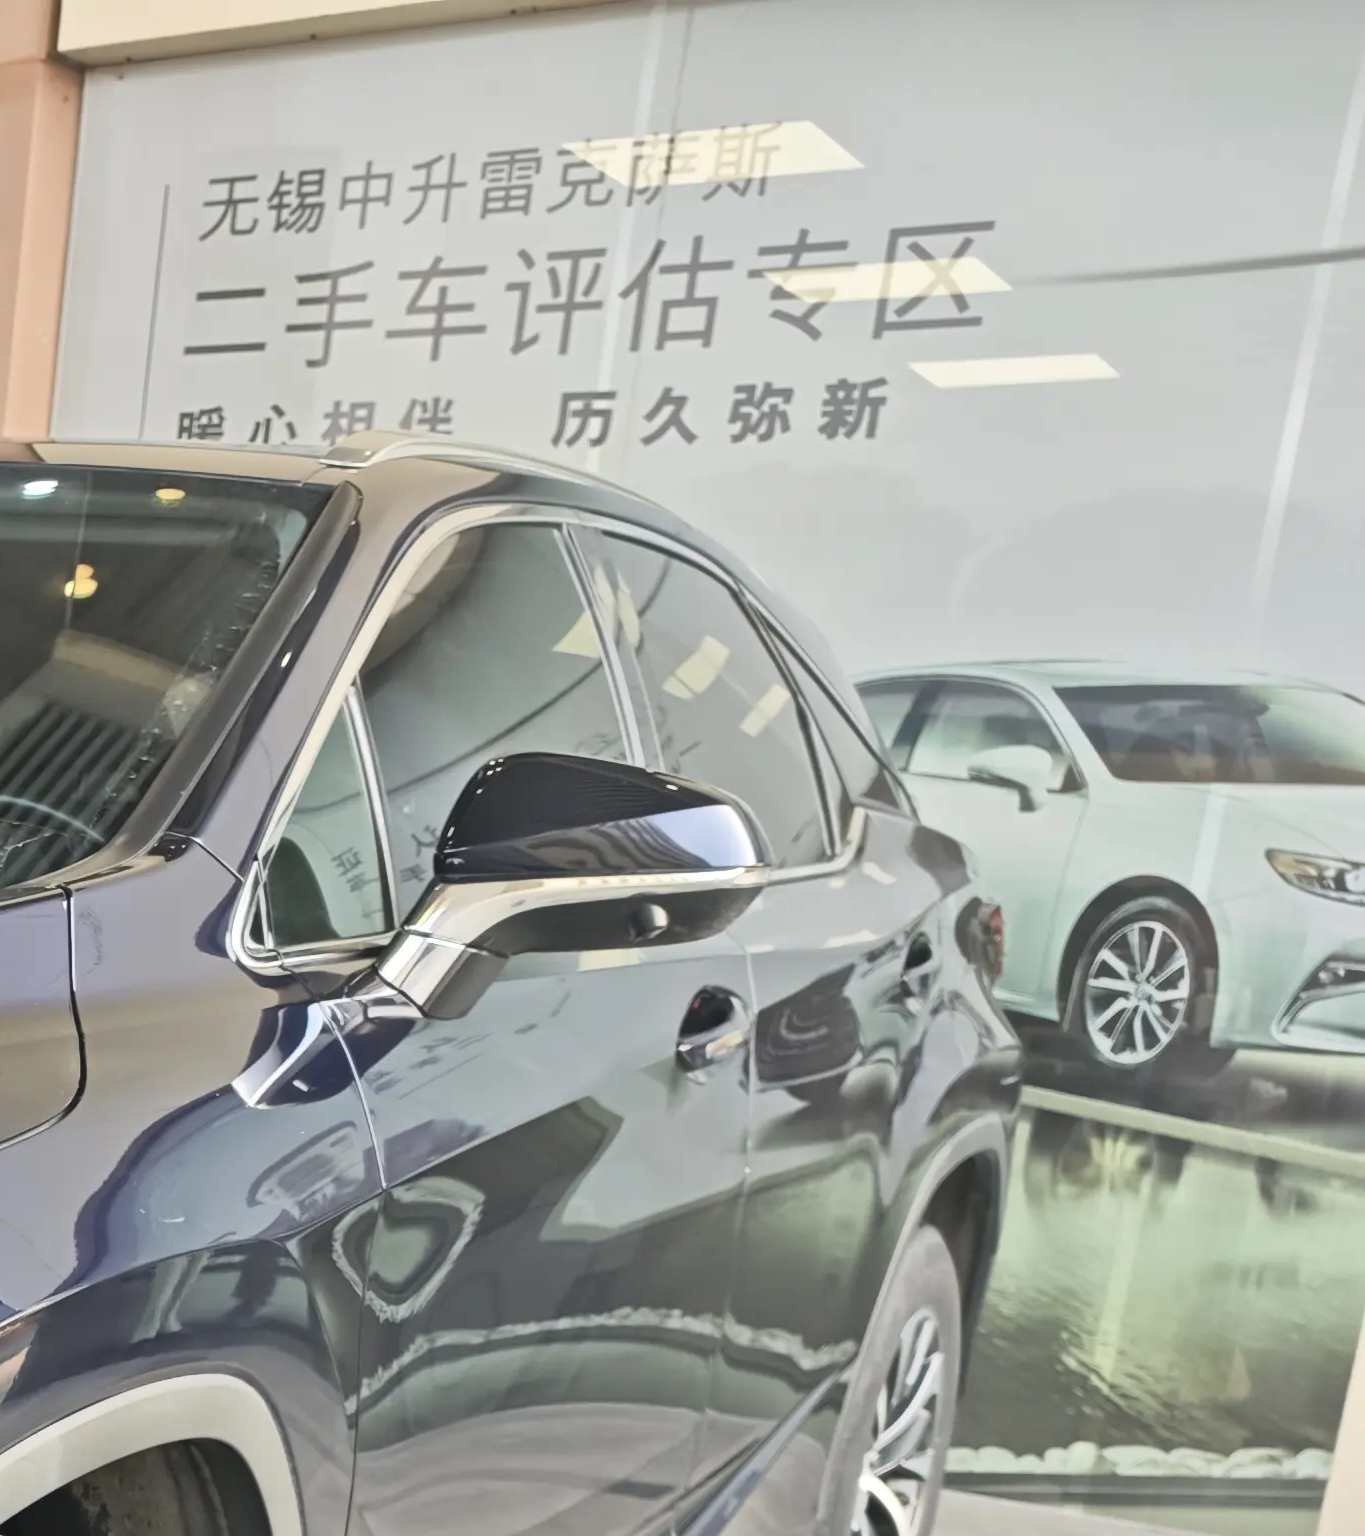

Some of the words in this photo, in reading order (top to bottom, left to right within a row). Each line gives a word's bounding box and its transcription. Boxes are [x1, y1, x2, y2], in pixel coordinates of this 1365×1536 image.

[198, 121, 782, 243] 无锡中升雷克萨斯
[183, 219, 998, 370] 二手车评估专区
[176, 396, 455, 446] 暖心相伴
[550, 376, 889, 450] 历久弥新
